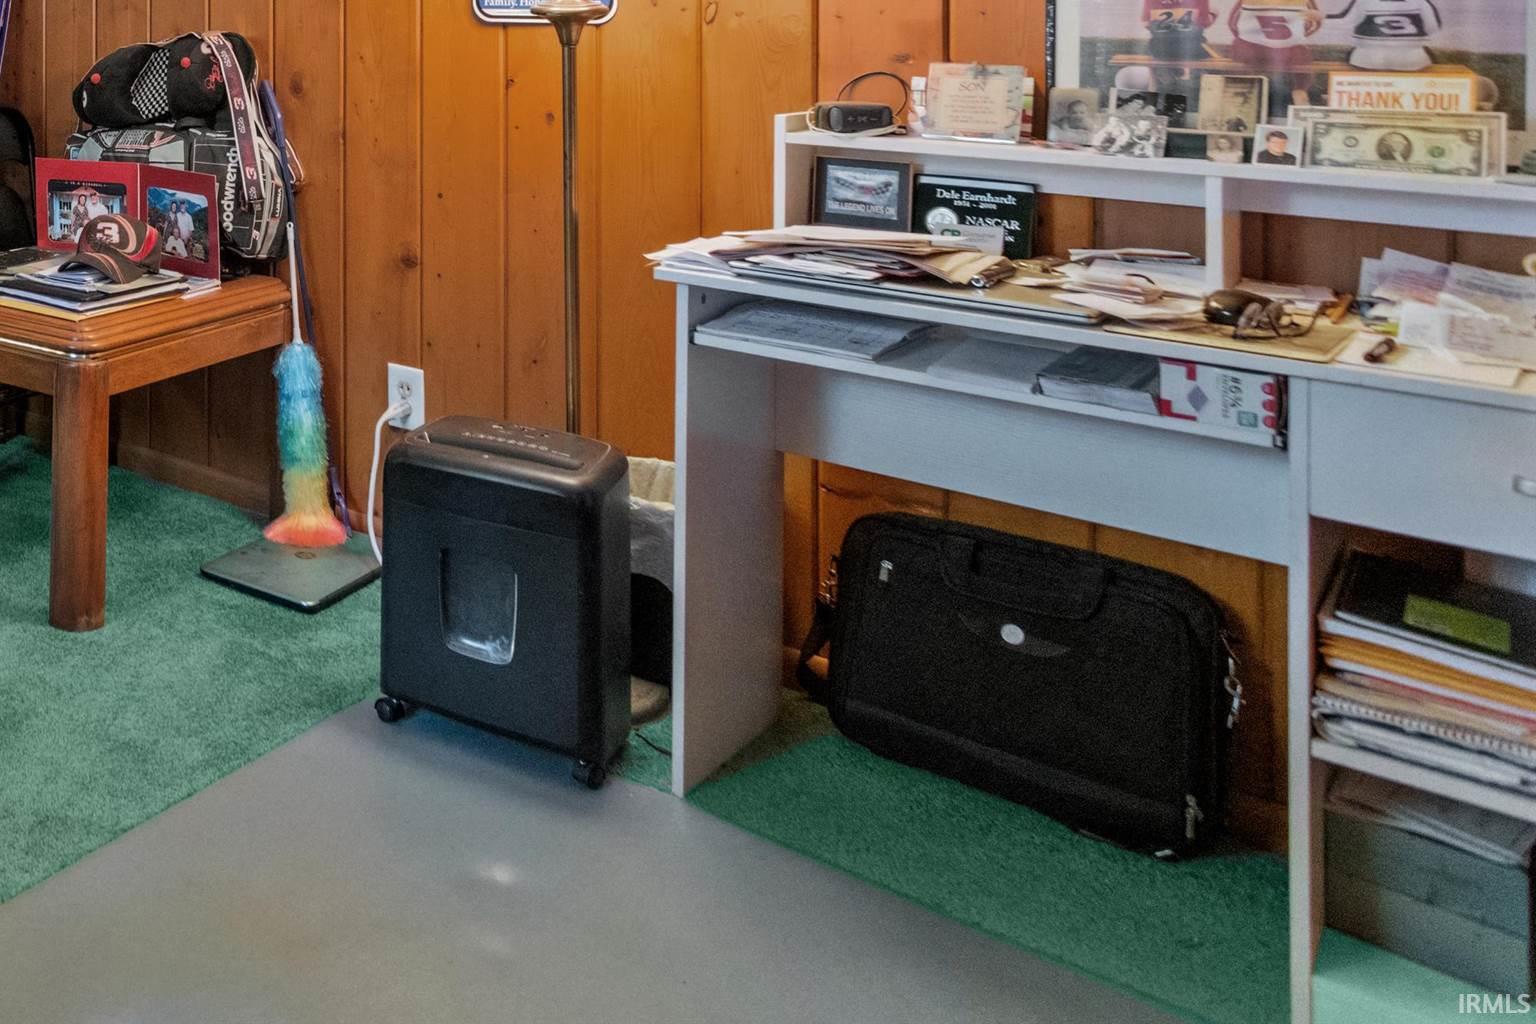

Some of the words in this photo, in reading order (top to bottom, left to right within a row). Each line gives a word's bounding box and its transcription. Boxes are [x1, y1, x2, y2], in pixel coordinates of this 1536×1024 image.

[1157, 10, 1194, 31] 24
[1256, 15, 1292, 40] 5
[1374, 15, 1418, 35] 3
[234, 97, 244, 110] 3
[1336, 90, 1404, 109] THANK
[1411, 93, 1460, 110] YOU!
[245, 166, 257, 180] 3
[221, 148, 238, 232] oodwrench
[935, 188, 961, 199] Dale
[962, 191, 1017, 205] Earnhardt
[96, 222, 120, 243] 3
[965, 216, 1021, 231] NASCAR
